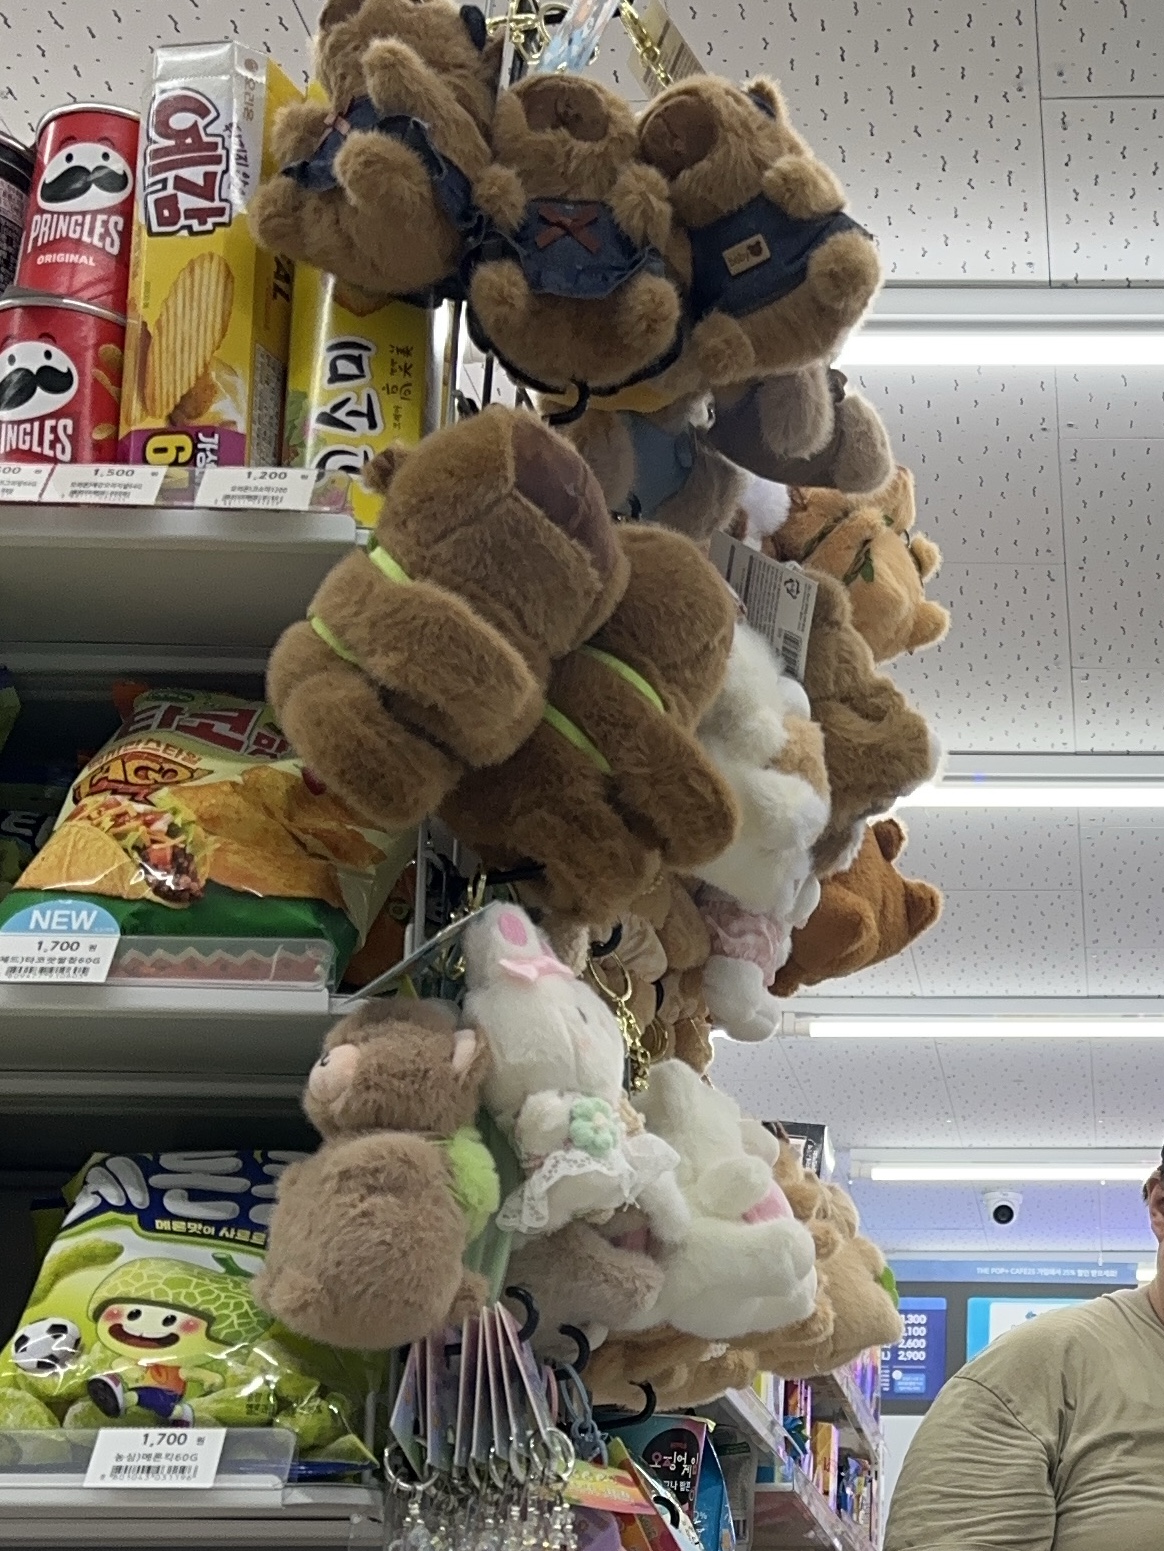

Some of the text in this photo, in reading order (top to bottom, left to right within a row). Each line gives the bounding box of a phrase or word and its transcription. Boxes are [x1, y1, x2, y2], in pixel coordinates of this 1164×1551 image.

[147, 89, 230, 232] 예감
[27, 214, 125, 257] PRINGLES
[36, 252, 97, 267] ORIGINAL
[0, 417, 74, 463] INGLES
[73, 756, 195, 805] TACO
[29, 909, 98, 931] NEW
[36, 940, 80, 953] 1,700
[902, 1313, 927, 1324] ,300
[902, 1326, 927, 1337] ,100
[142, 1432, 188, 1448] 1,700
